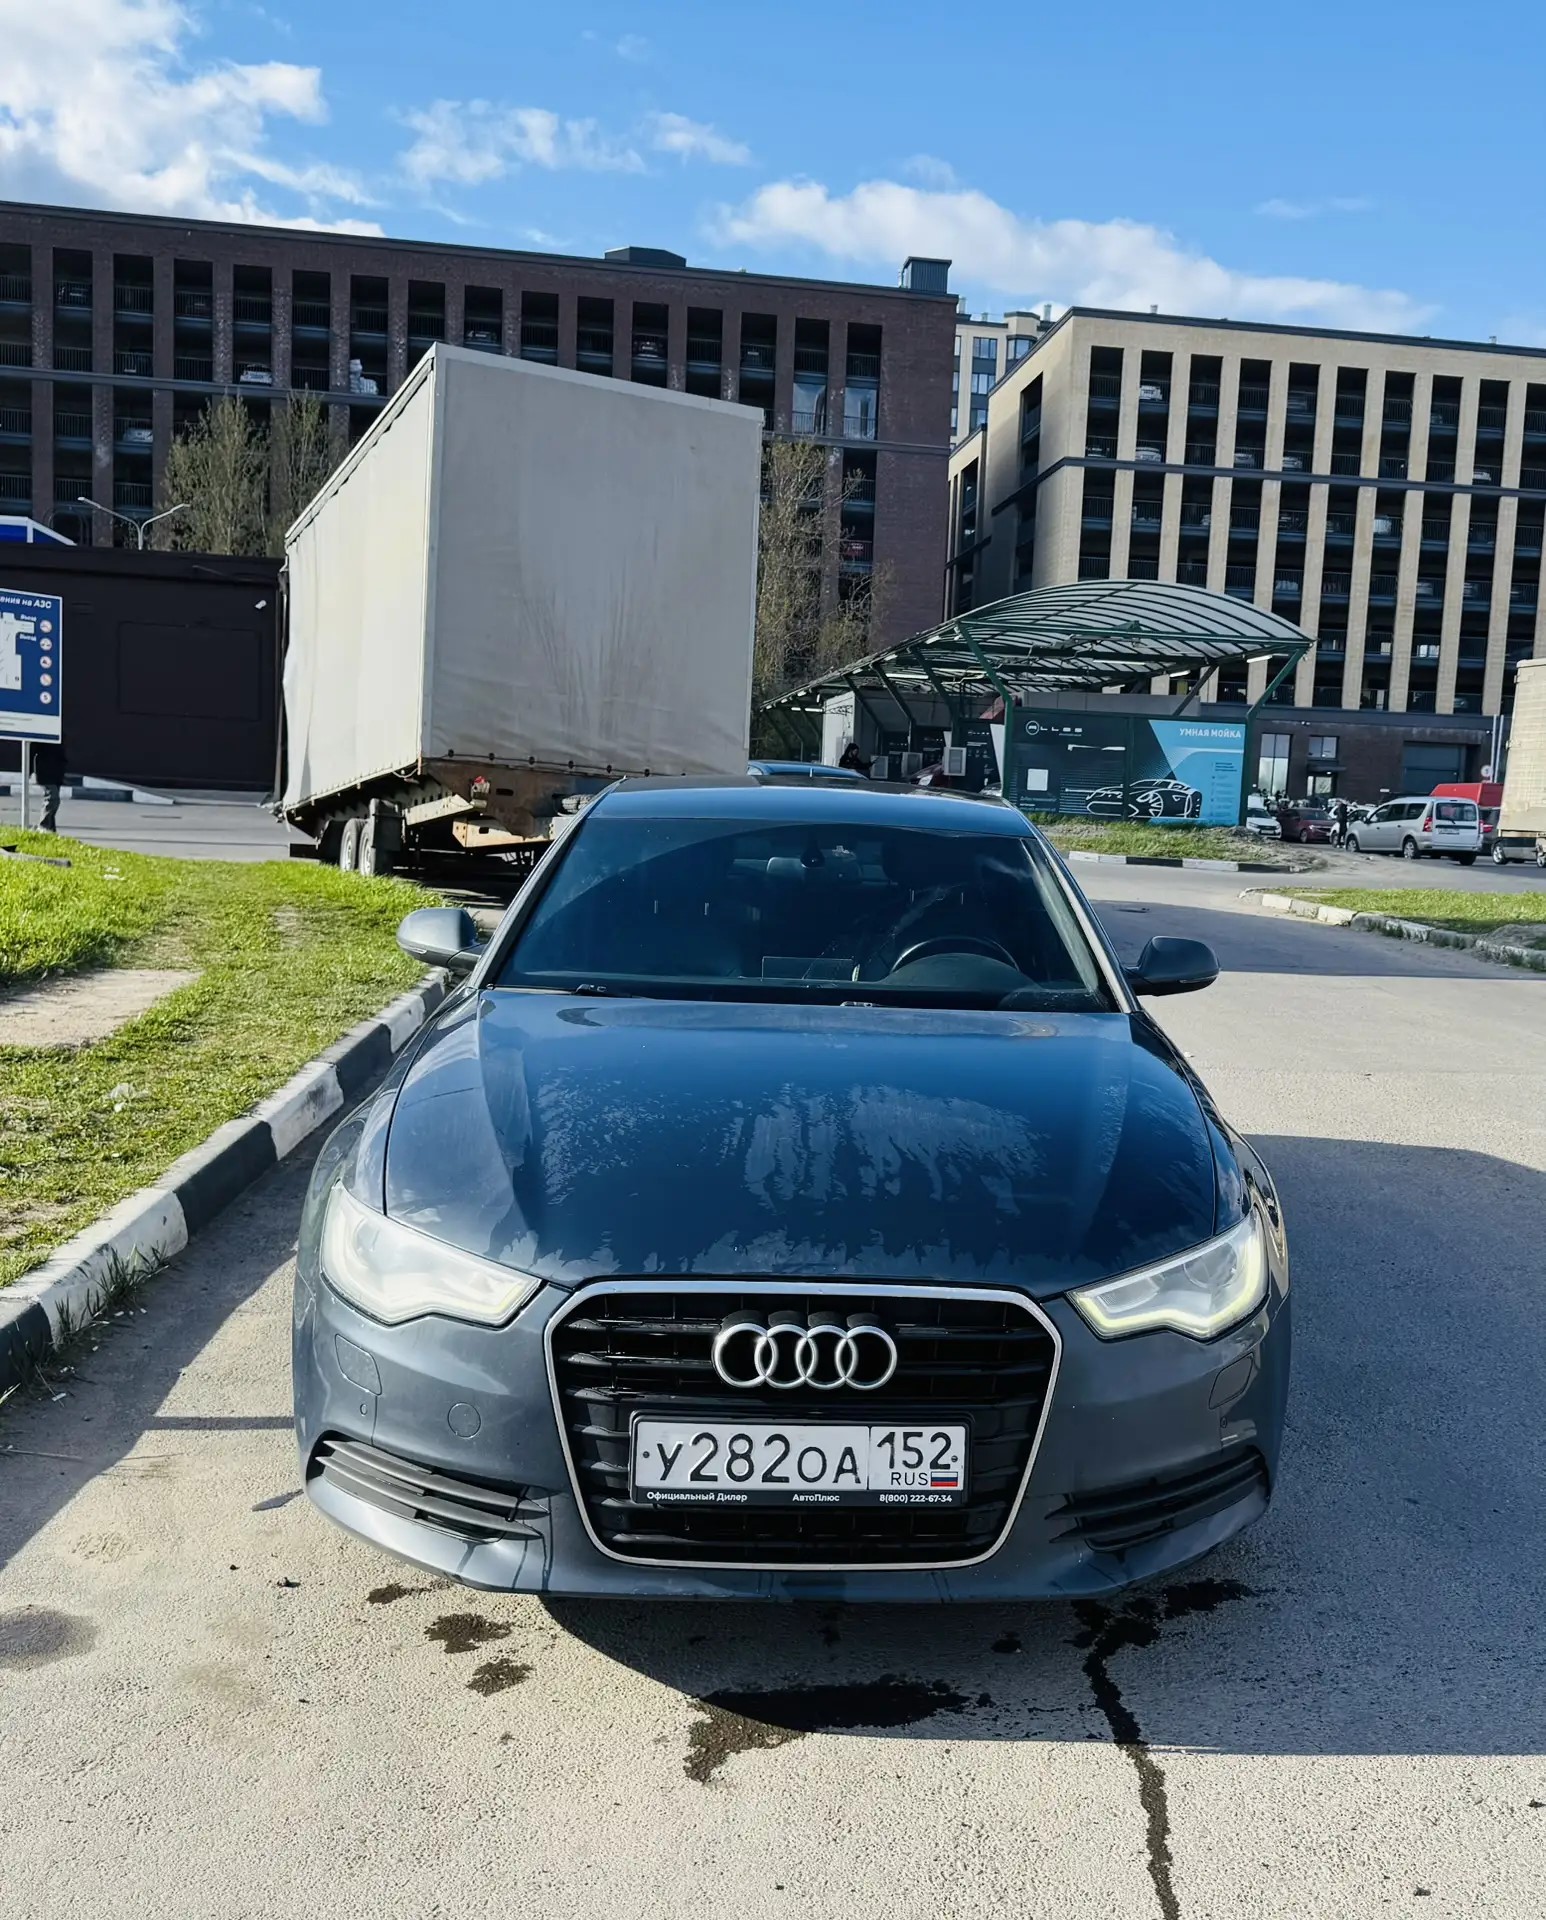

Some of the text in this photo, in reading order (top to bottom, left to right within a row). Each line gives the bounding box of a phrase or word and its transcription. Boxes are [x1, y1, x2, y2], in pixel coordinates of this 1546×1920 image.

[33, 600, 52, 609] АЗС
[1180, 728, 1242, 738] УМНАЯ МОЙКА
[656, 1432, 951, 1483] У282ОА 152
[891, 1472, 928, 1486] RUS
[646, 1491, 747, 1502] Официальный Дилер
[792, 1494, 840, 1502] АвтоПлюс
[879, 1494, 908, 1503] 8(800)
